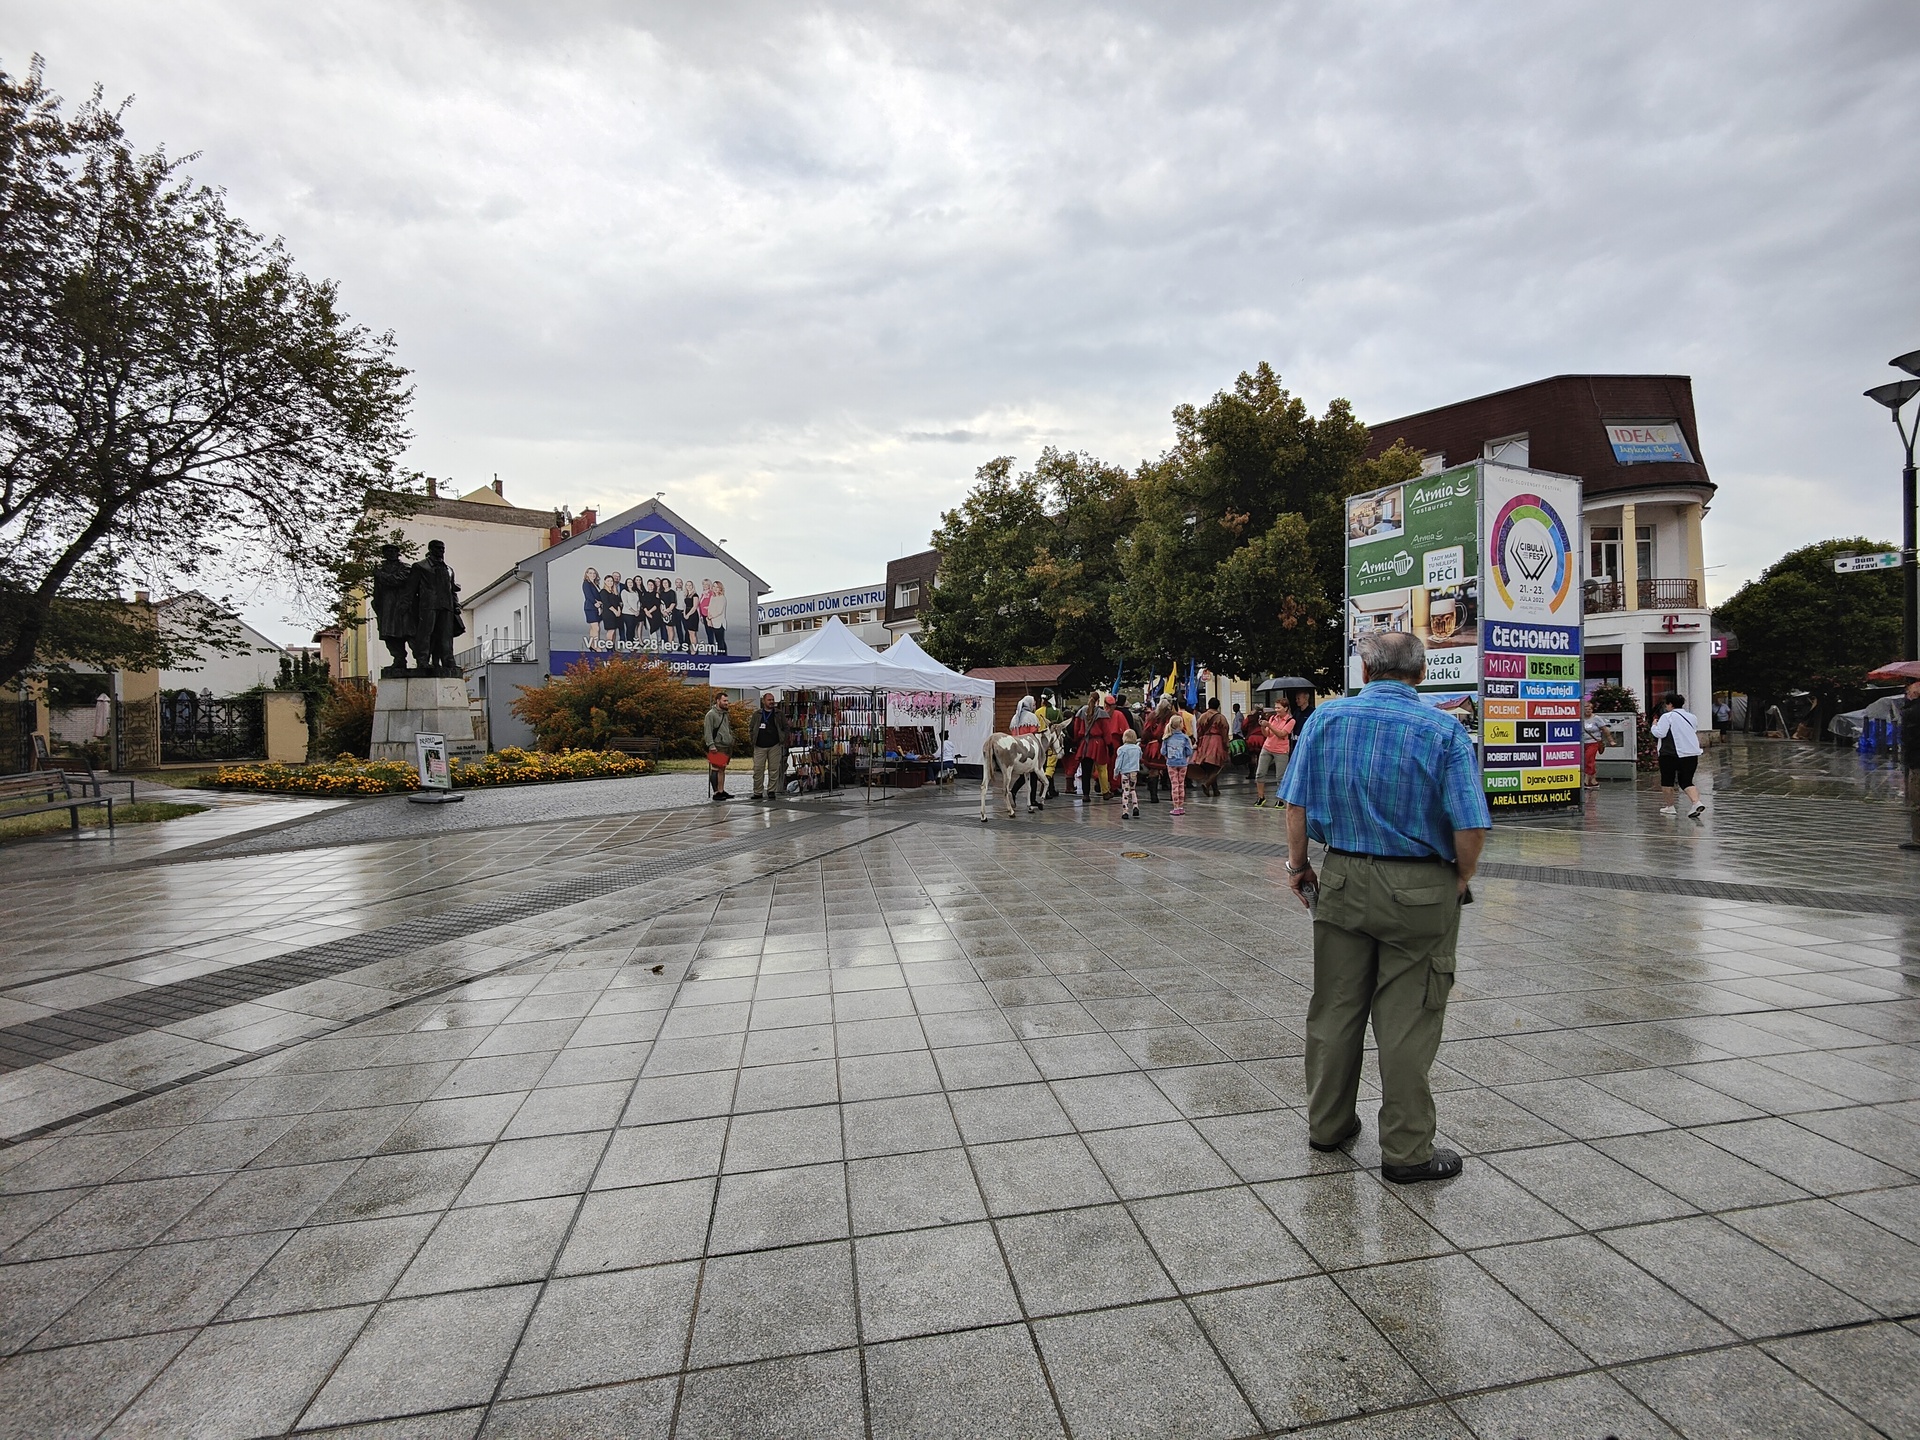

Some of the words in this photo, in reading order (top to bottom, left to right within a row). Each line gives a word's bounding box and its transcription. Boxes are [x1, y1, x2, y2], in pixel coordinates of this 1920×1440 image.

[1613, 429, 1657, 443] IDEA
[1409, 482, 1454, 508] Armia
[1412, 500, 1453, 515] restaurace
[1410, 531, 1435, 545] Armia
[1520, 542, 1544, 553] CIBULA
[638, 550, 673, 559] REALITY
[1528, 553, 1545, 561] FEST
[640, 557, 672, 568] GAIA
[1356, 557, 1395, 577] Armia
[1360, 575, 1391, 587] pivnice
[1429, 566, 1457, 583] PÉČI
[767, 599, 816, 618] OBCHODNÍ
[818, 596, 840, 611] DŮM
[842, 590, 886, 607] CENTRU
[583, 636, 614, 649] Více
[617, 637, 640, 650] než
[643, 639, 658, 650] 28
[661, 639, 679, 650] let
[681, 642, 689, 651] s
[1492, 625, 1570, 650] ČECHOMOR
[1426, 653, 1462, 666] vězda
[1489, 659, 1522, 673] MIRAI
[1426, 667, 1460, 680] ládků
[1487, 684, 1515, 694] FLERET
[1525, 684, 1545, 695] Vašo
[1546, 685, 1574, 697] Patejdl
[1488, 705, 1520, 714] POLEMIC
[1490, 726, 1509, 739] Sima
[1523, 727, 1540, 737] EKG
[1554, 727, 1573, 737] KALI
[1487, 752, 1512, 761] ROBERT
[1512, 751, 1538, 761] BURIAN
[1545, 751, 1575, 760] MANENE
[1487, 777, 1518, 787] PUERTO
[1547, 774, 1568, 784] QUEEN
[1569, 774, 1574, 782] B
[1492, 793, 1517, 805] AREÁL
[1518, 793, 1549, 804] LETISKA
[1549, 790, 1572, 802] HOLÍČ
